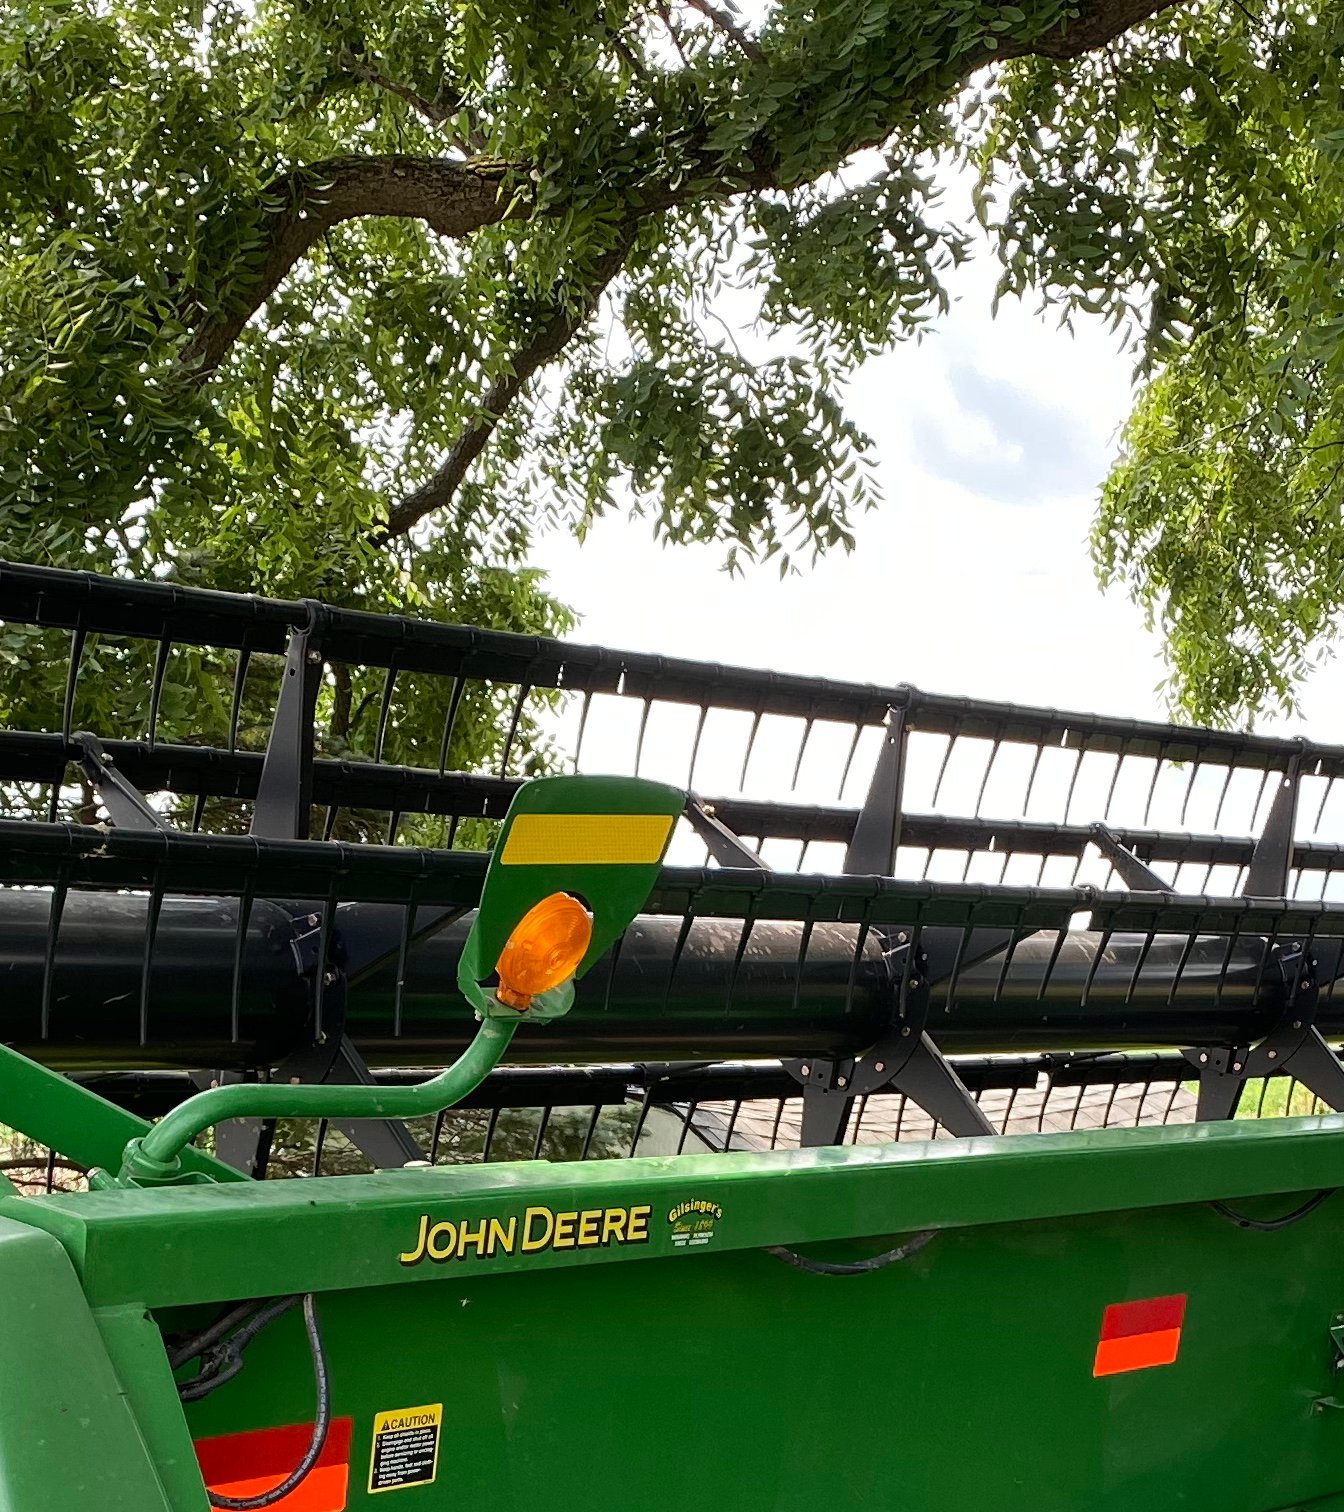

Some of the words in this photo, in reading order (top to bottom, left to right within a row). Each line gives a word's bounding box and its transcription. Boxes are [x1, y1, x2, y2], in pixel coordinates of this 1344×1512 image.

[399, 1215, 516, 1264] JOHN
[521, 1205, 652, 1252] DEERE
[390, 1413, 436, 1430] CAUTION
